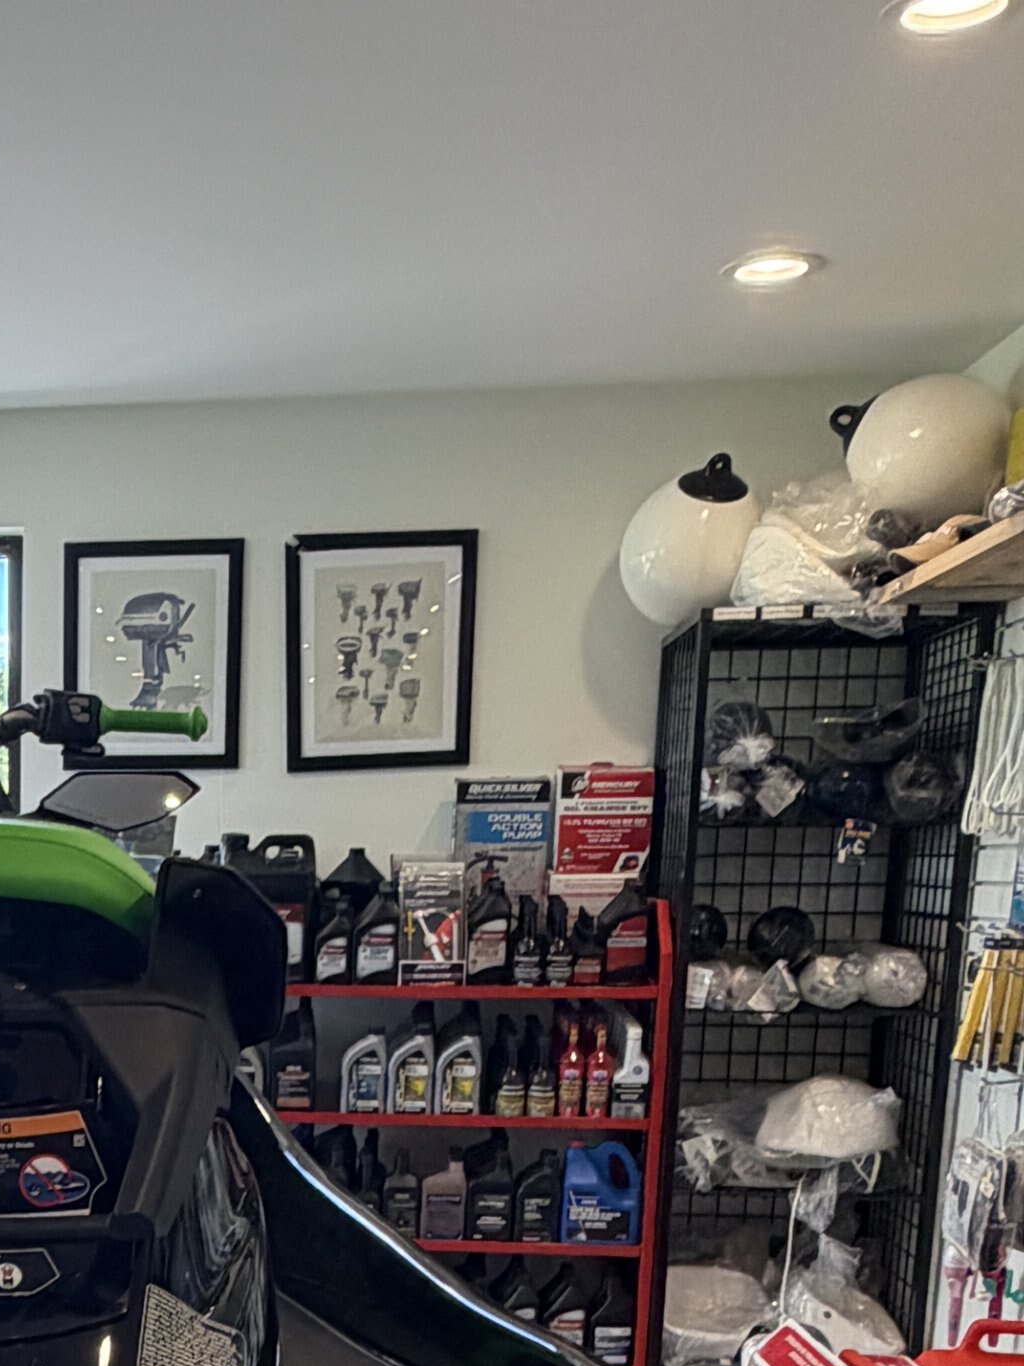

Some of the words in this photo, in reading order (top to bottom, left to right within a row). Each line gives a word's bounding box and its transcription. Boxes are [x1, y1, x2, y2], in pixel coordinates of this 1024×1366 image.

[468, 783, 543, 795] QUICKSILVER
[591, 781, 641, 789] MERCURY
[487, 813, 542, 823] DOUBLE
[491, 822, 542, 832] ACTION
[502, 831, 542, 840] PUMP
